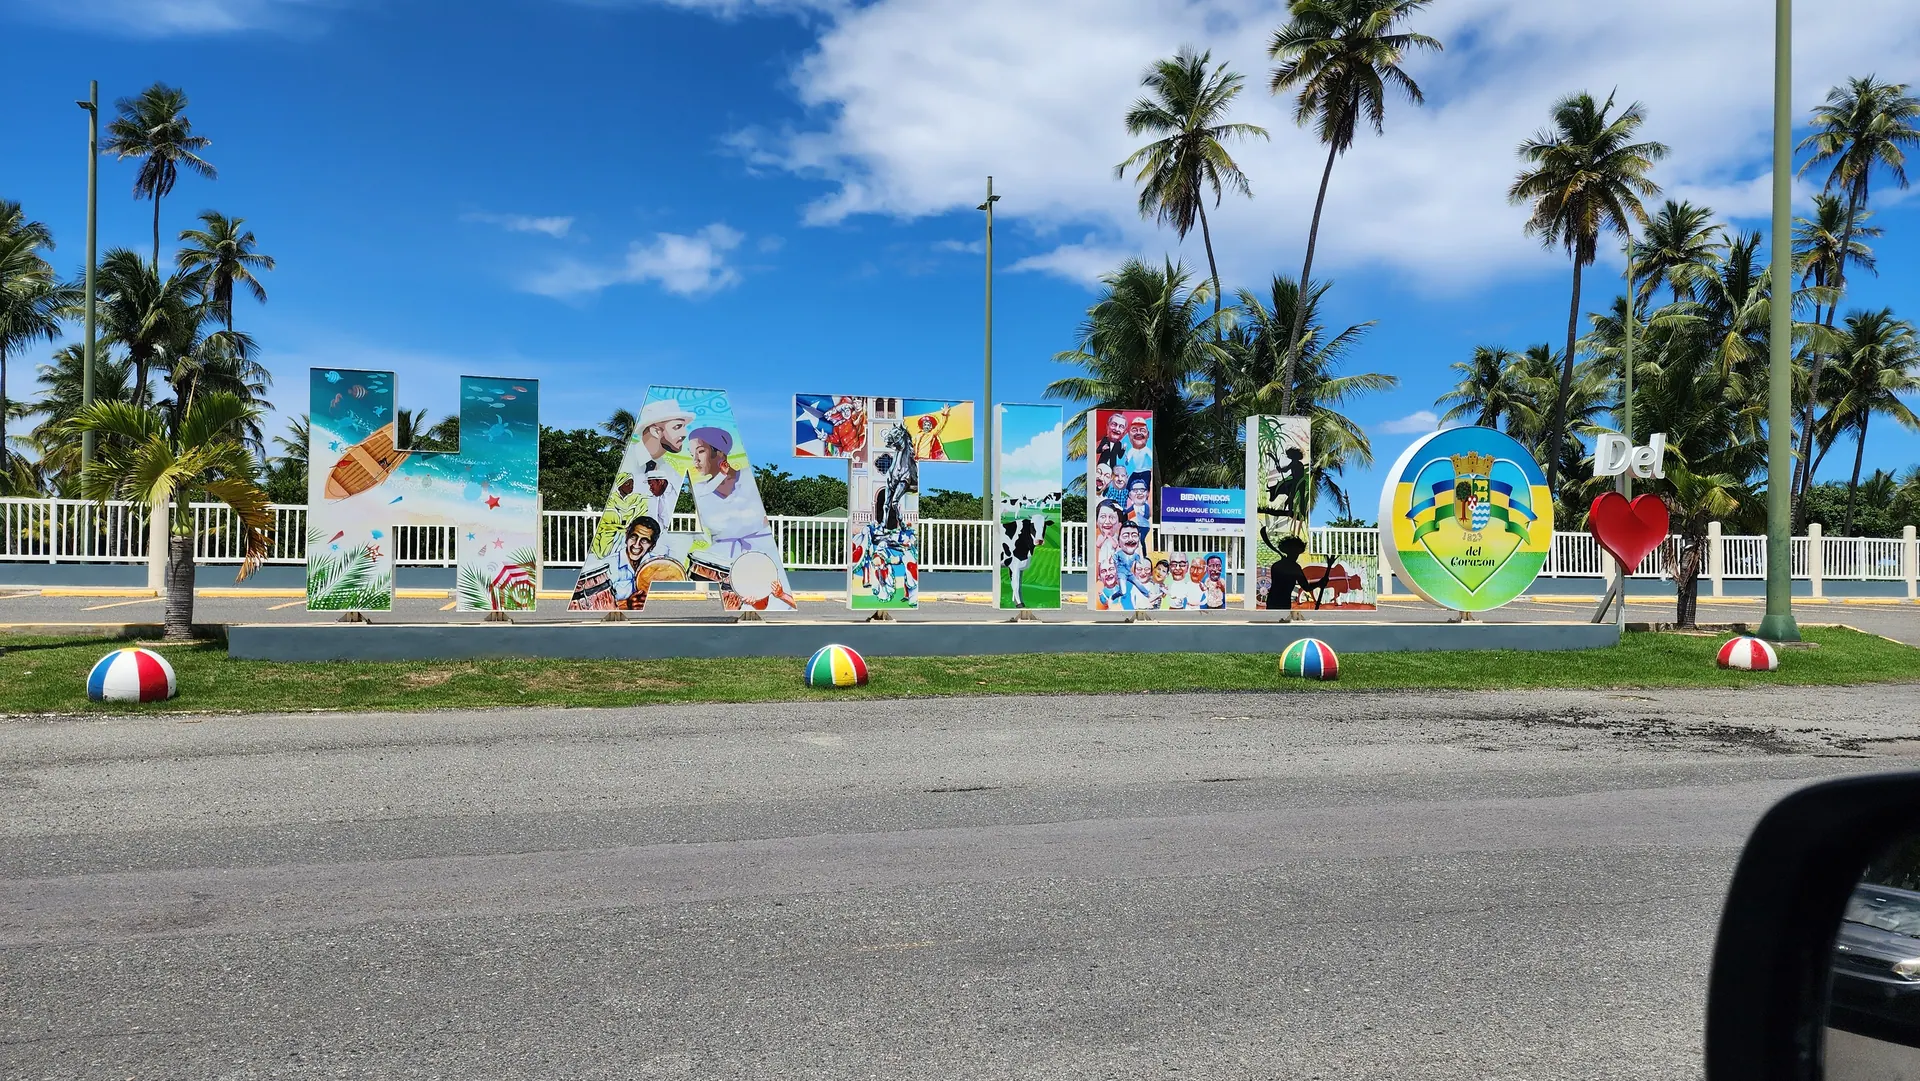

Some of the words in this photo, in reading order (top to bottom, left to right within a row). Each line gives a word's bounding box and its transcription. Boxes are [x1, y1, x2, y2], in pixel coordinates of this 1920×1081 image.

[1593, 432, 1667, 480] Del
[306, 367, 1554, 613] HATILLO
[1180, 493, 1230, 501] BIENVENIDOS
[1462, 531, 1483, 542] 1823
[1465, 546, 1482, 556] del
[1450, 556, 1494, 567] Corazón
